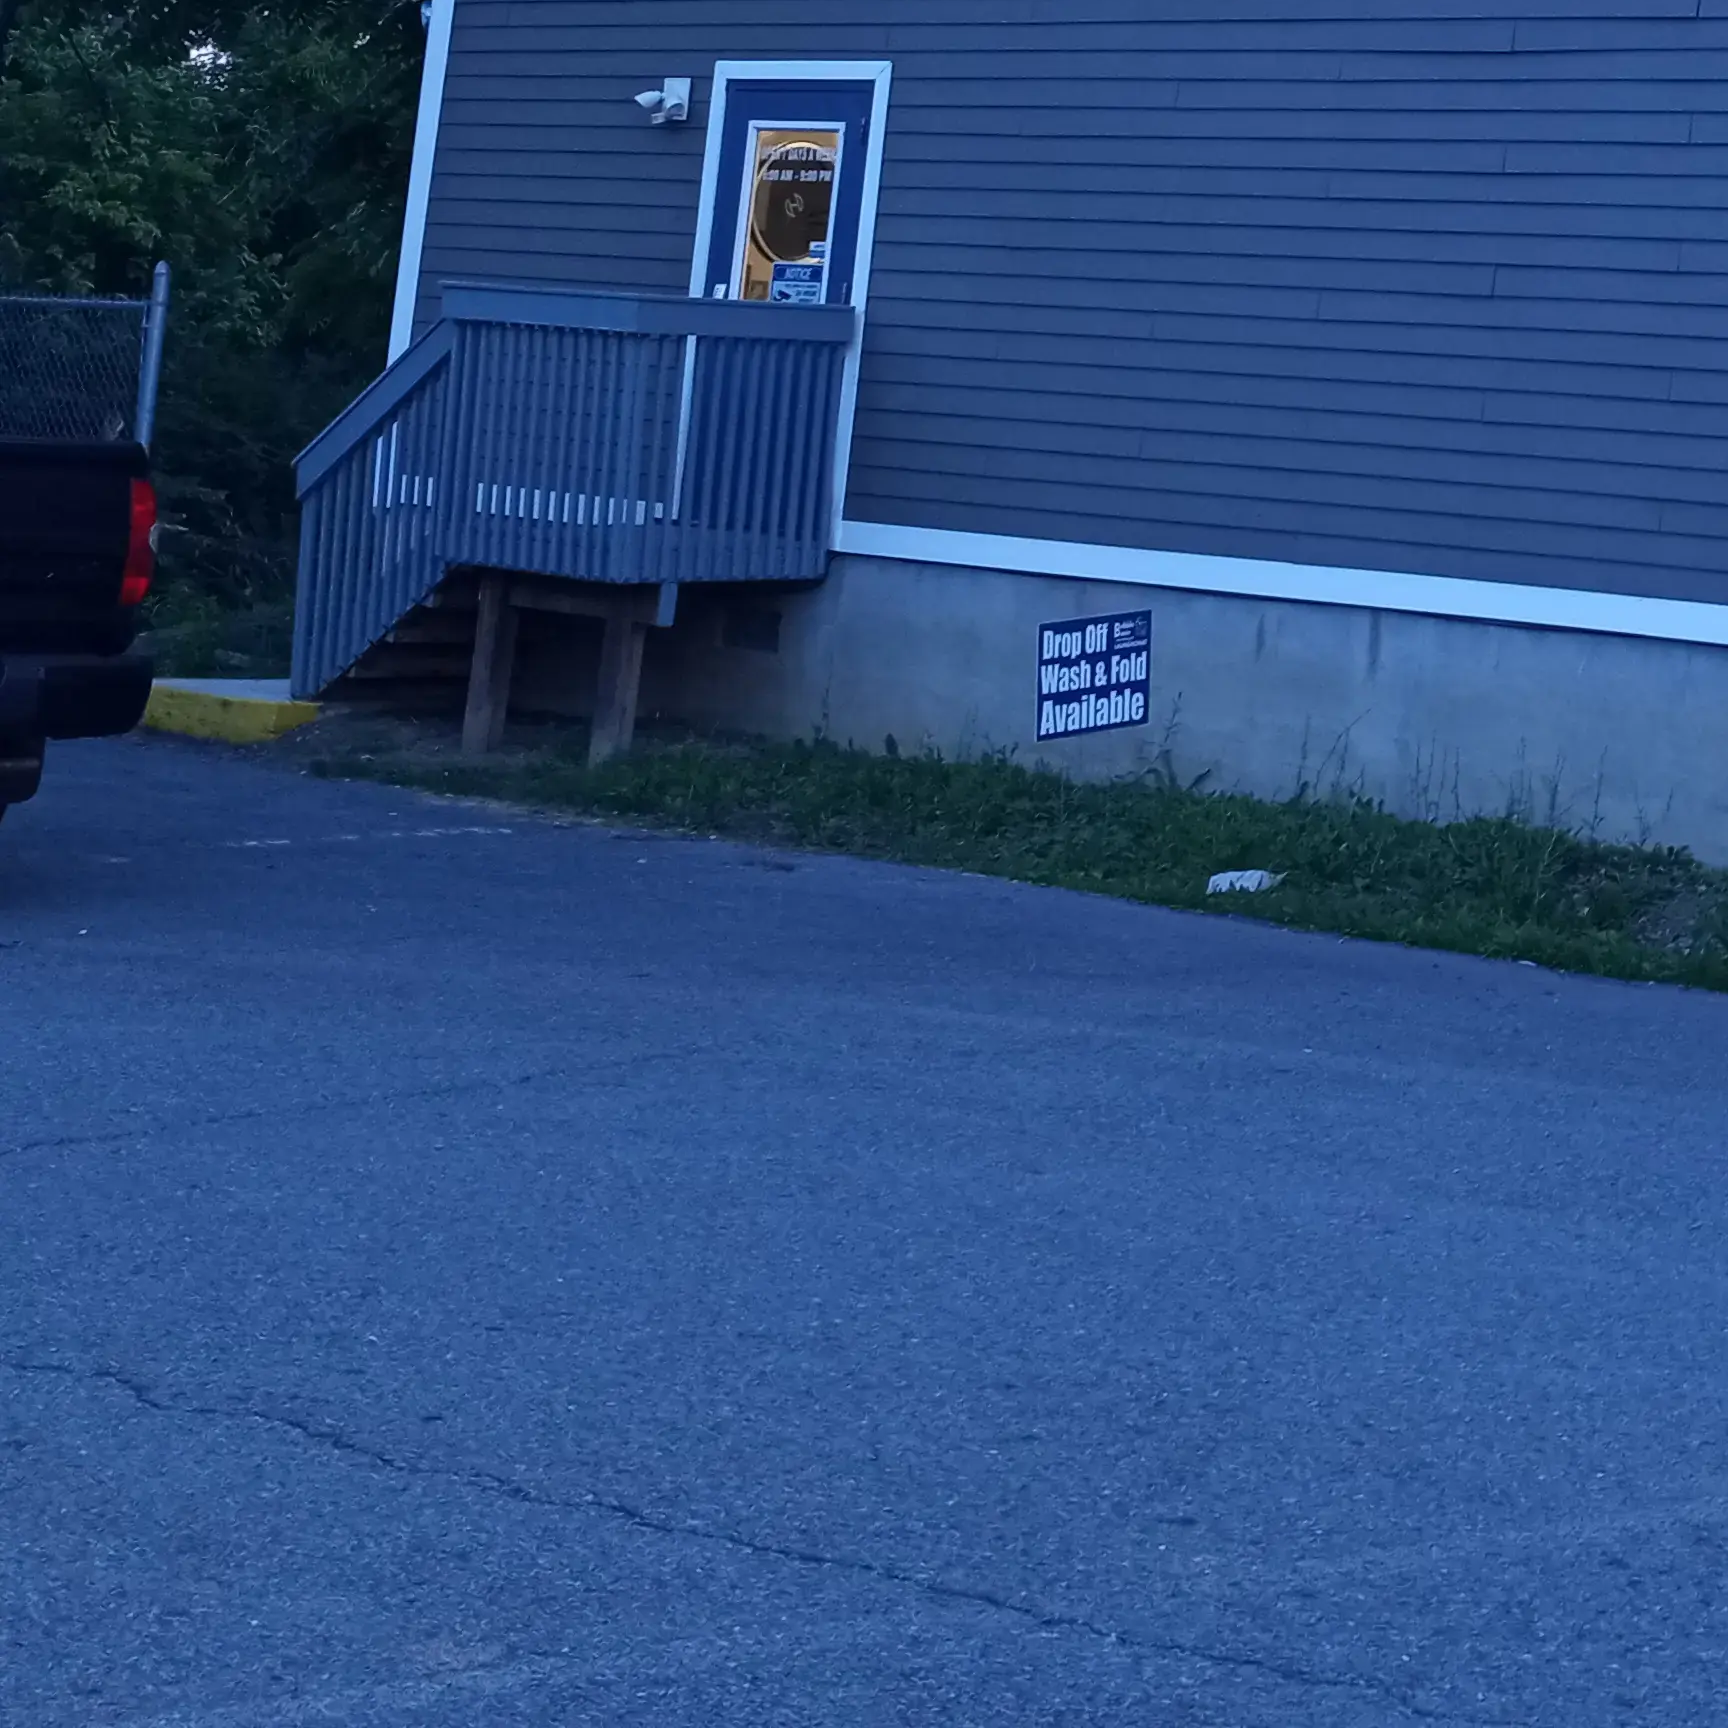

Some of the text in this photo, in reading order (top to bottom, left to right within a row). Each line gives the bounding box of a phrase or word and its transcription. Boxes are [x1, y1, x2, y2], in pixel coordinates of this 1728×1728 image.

[1042, 630, 1082, 660] Drop
[1085, 622, 1109, 654] Off
[1040, 651, 1147, 694] Wash & Fold
[1040, 688, 1144, 736] Available
